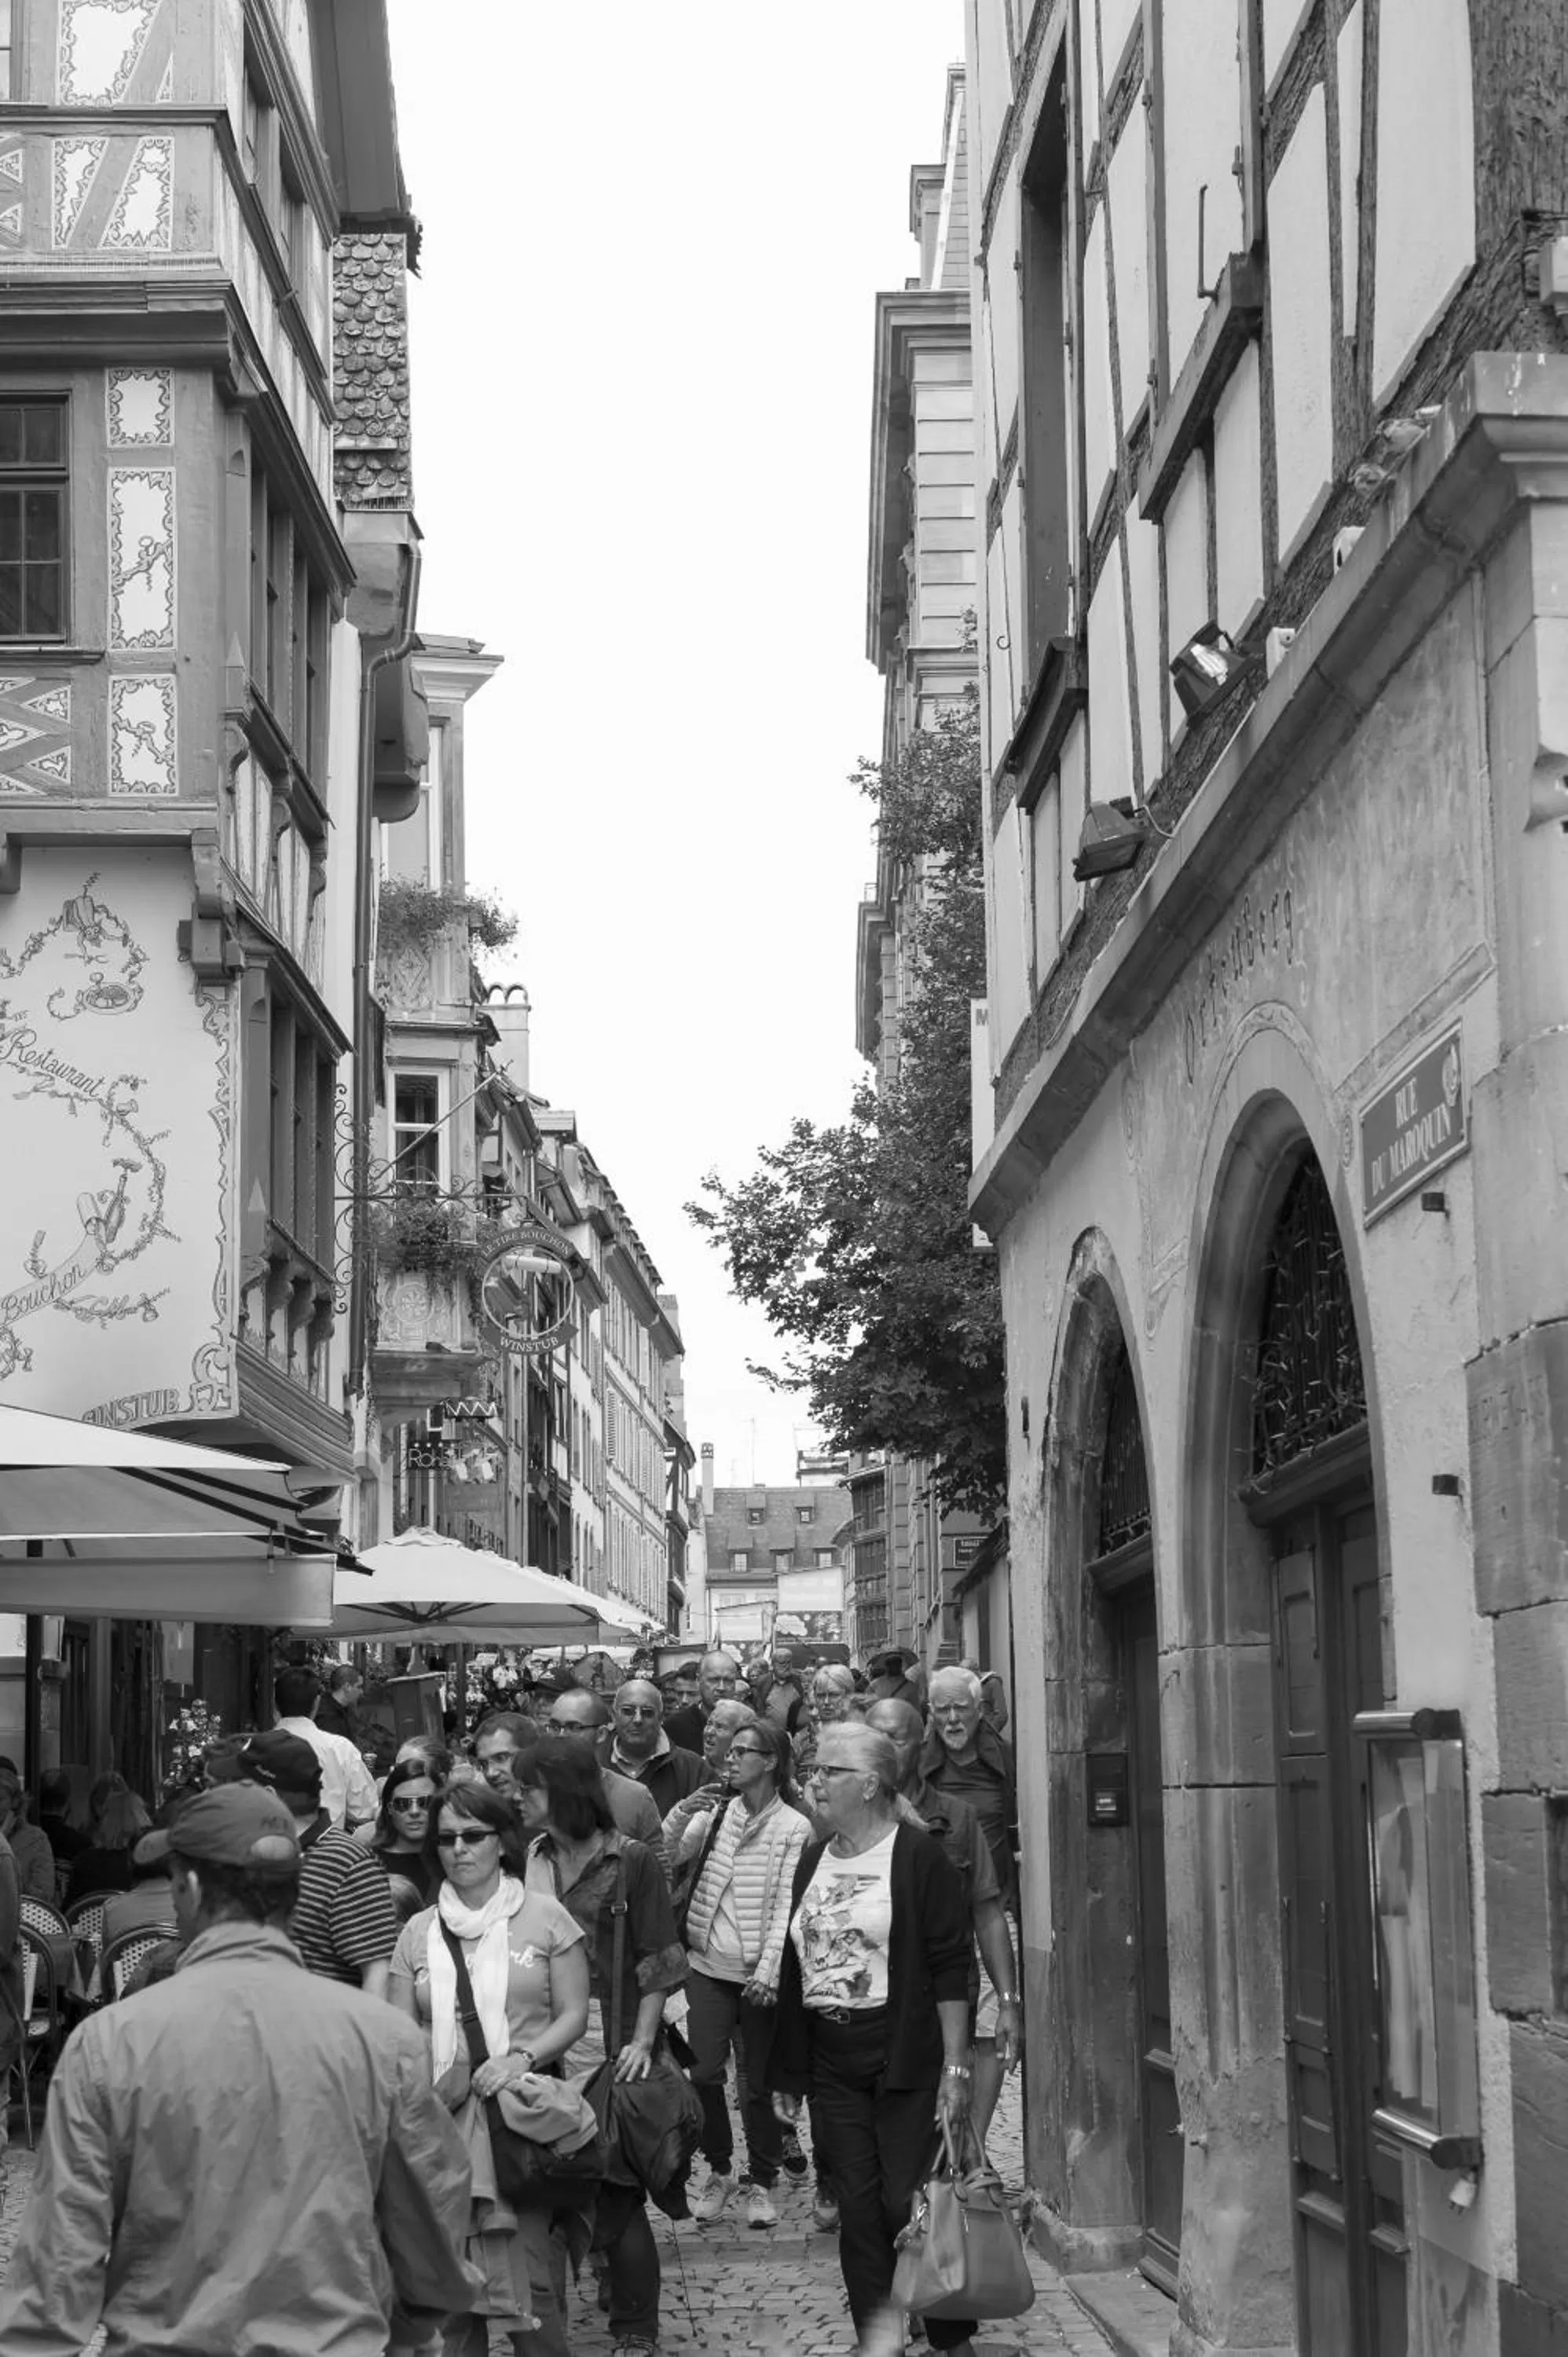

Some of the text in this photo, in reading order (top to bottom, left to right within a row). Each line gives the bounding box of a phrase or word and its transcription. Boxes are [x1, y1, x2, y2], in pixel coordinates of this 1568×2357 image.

[0, 1028, 104, 1098] Restaurant
[1395, 1078, 1417, 1129] RUE
[1372, 1102, 1451, 1196] DU MAROQUIN
[482, 1230, 569, 1257] LE TIRE BOUCHON
[1, 1263, 86, 1321] Bouchon
[500, 1337, 559, 1352] WINSTUB
